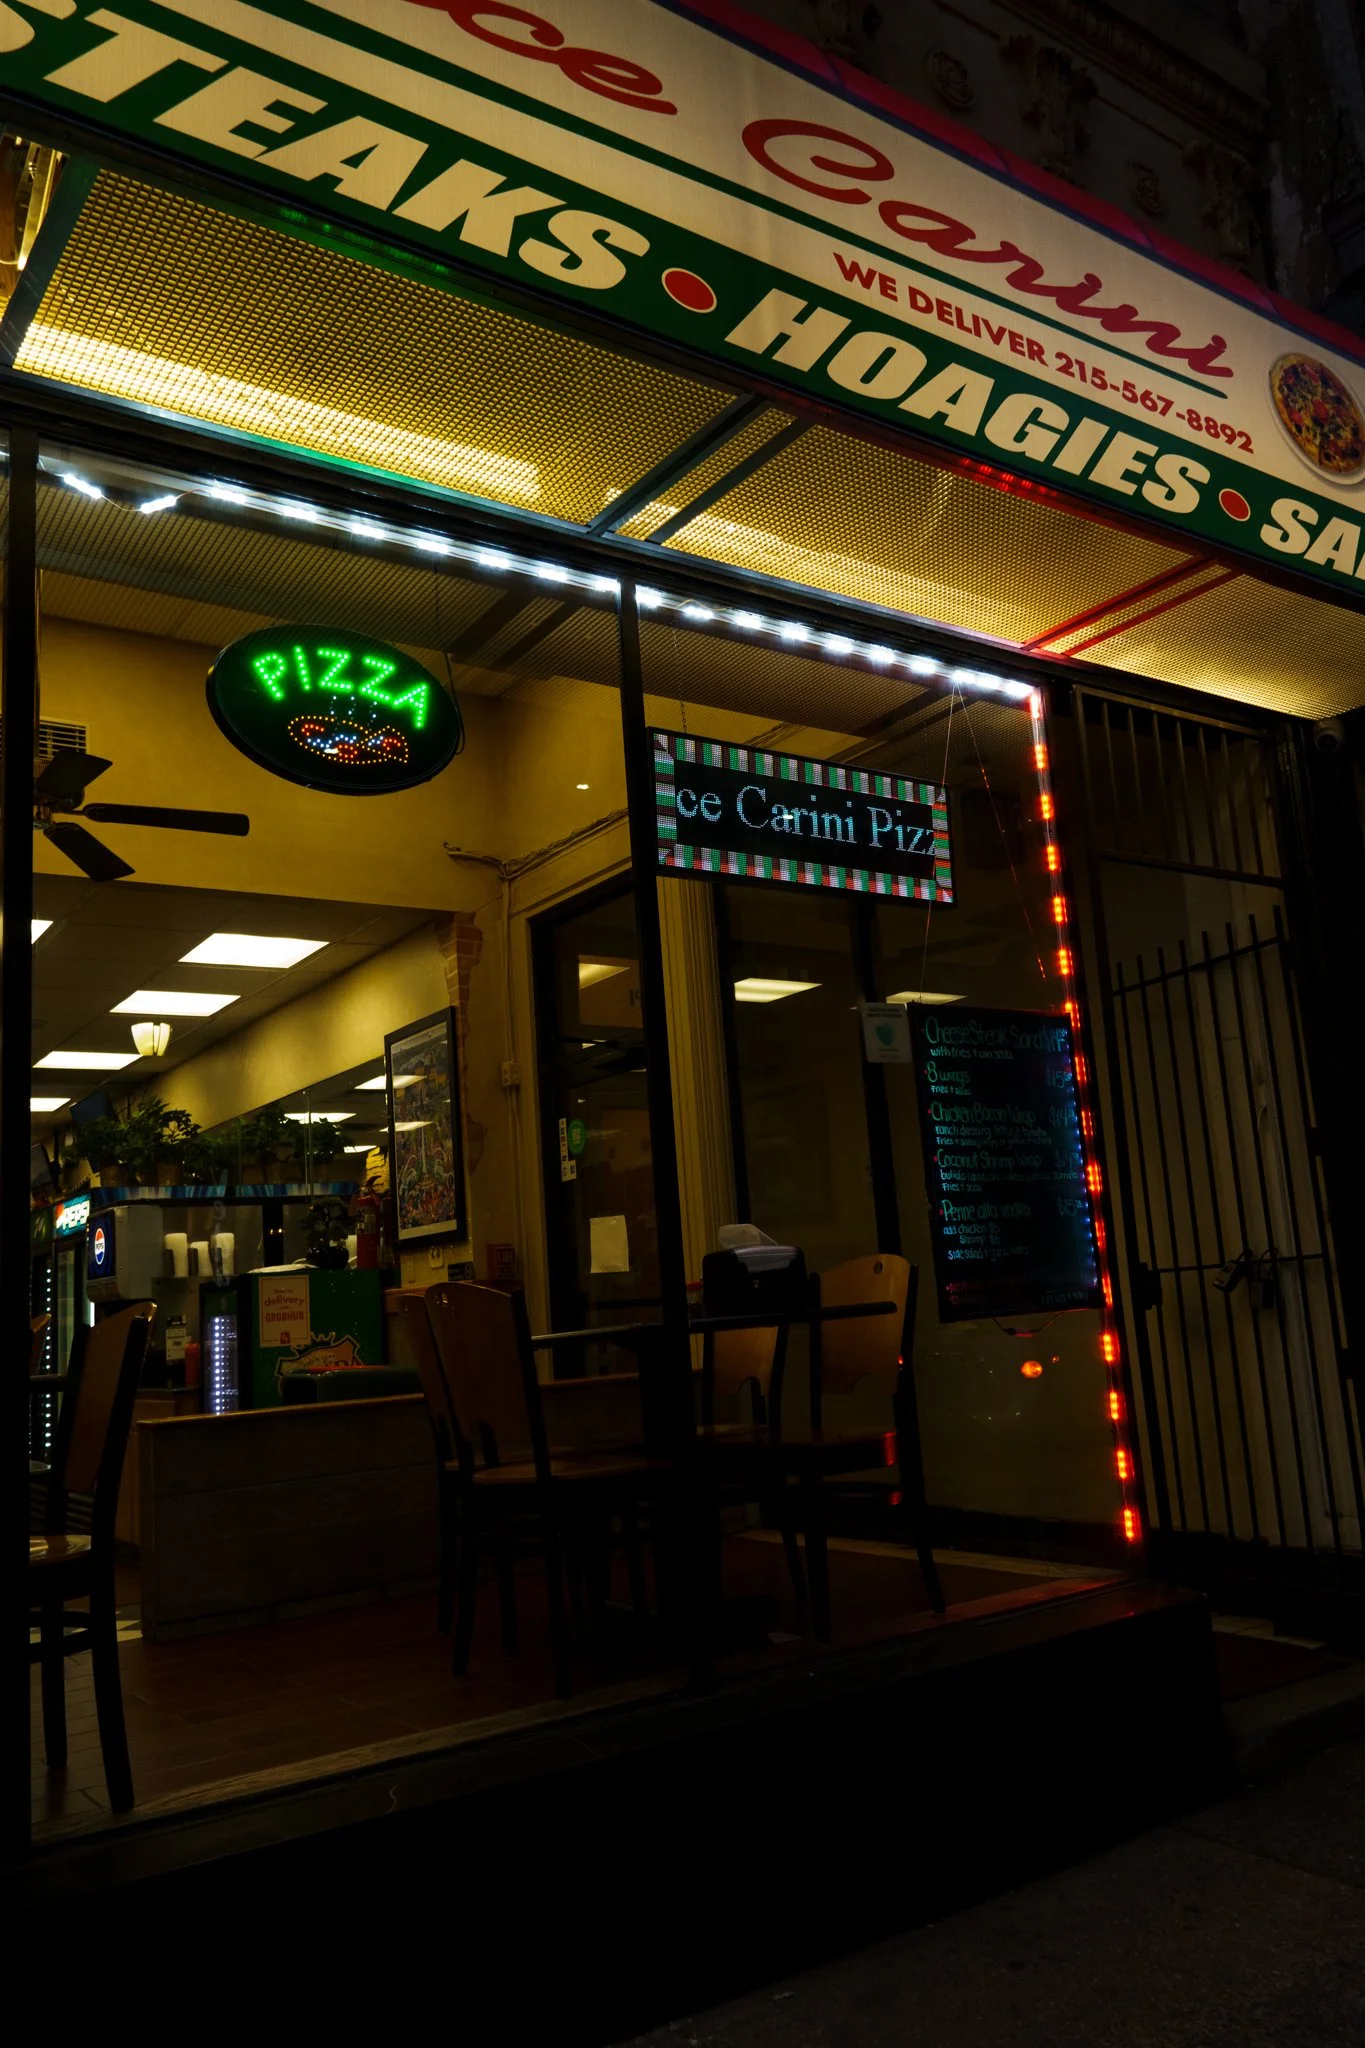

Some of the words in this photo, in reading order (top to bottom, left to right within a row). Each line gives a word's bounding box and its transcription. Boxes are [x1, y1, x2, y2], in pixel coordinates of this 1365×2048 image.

[408, 0, 678, 115] ce
[741, 117, 1236, 378] Carini
[833, 252, 898, 301] WE
[908, 286, 1048, 367] DELIVER
[1054, 351, 1255, 455] 215-567-8892
[722, 286, 1213, 514] HOAGIES
[1259, 497, 1365, 582] SA
[252, 645, 430, 729] PIZZA
[675, 787, 723, 824] ce
[736, 785, 858, 844] Carini
[930, 1046, 951, 1057] with
[927, 1061, 938, 1083] 8
[941, 1199, 976, 1221] Penne
[943, 1225, 957, 1235] add
[264, 1296, 305, 1307] delivery
